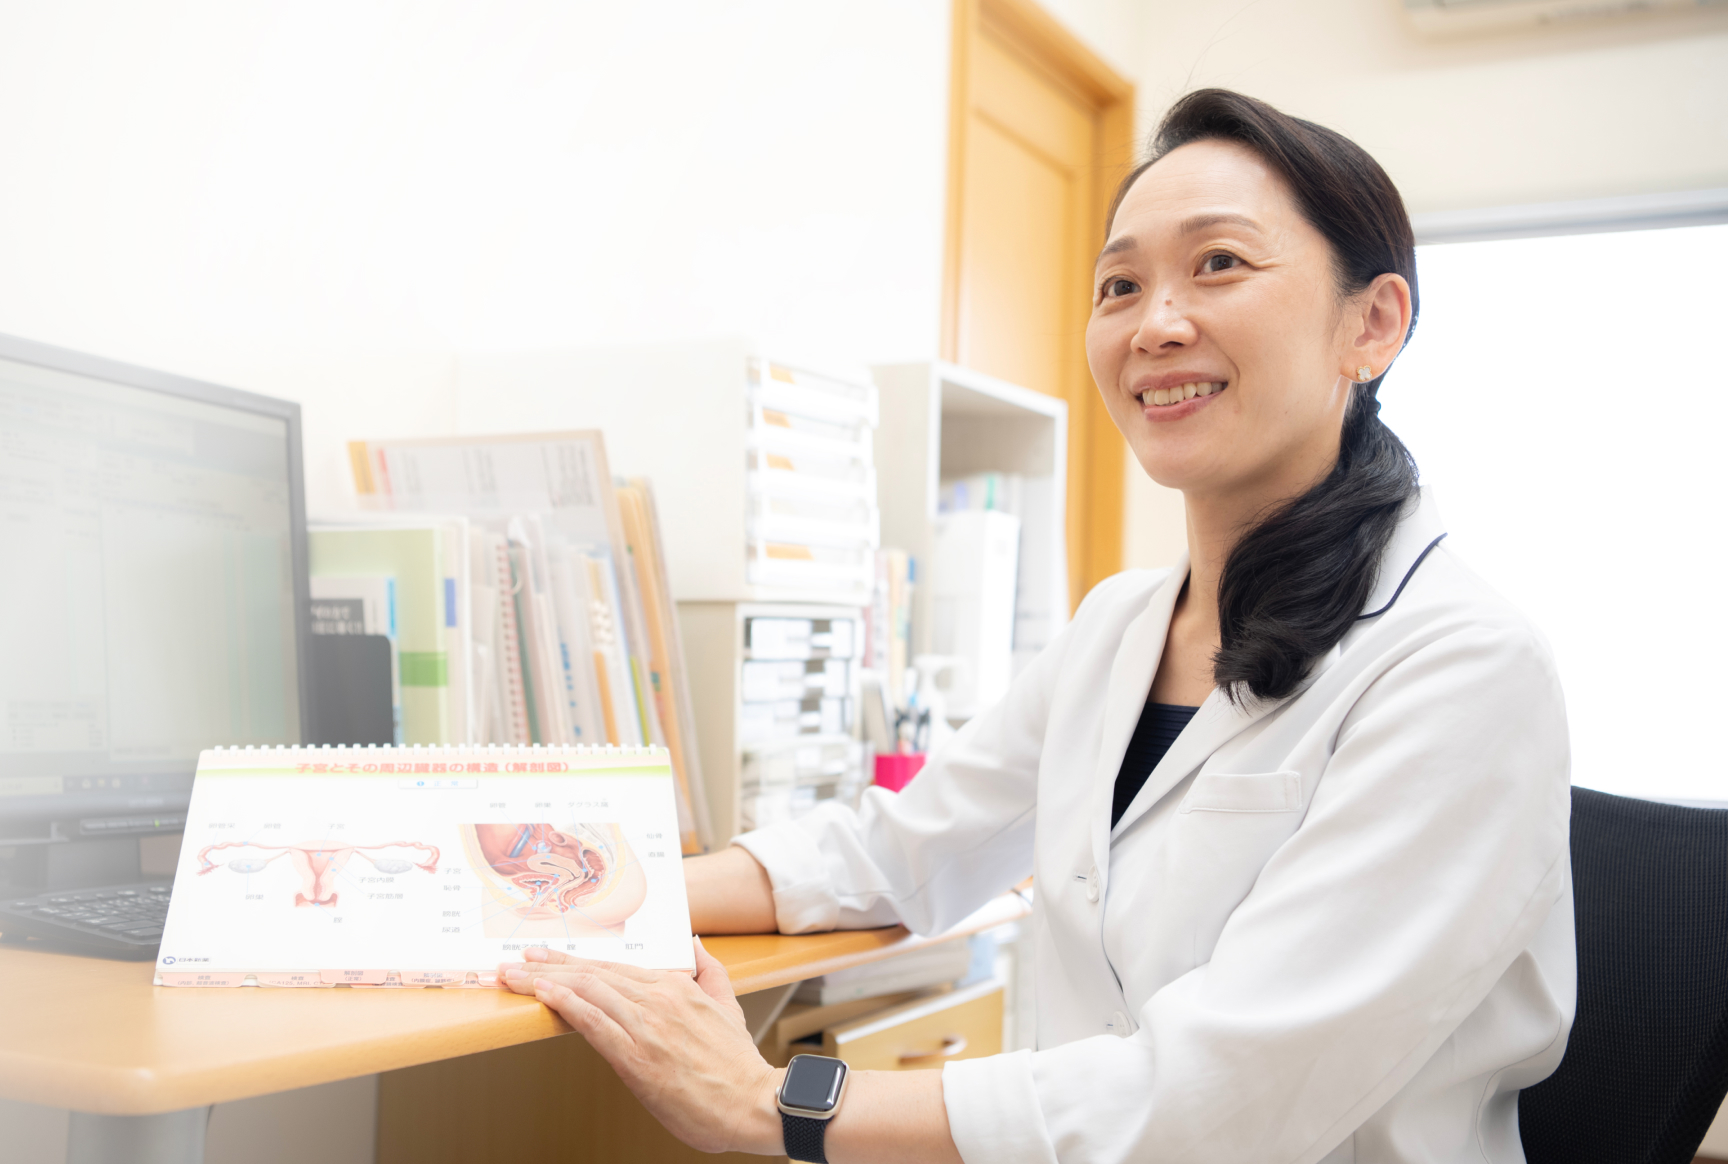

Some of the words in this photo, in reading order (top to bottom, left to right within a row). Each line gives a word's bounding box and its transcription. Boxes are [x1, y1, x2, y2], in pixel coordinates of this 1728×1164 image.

[444, 867, 462, 875] 子宮
[358, 876, 395, 884] 子宮内膜
